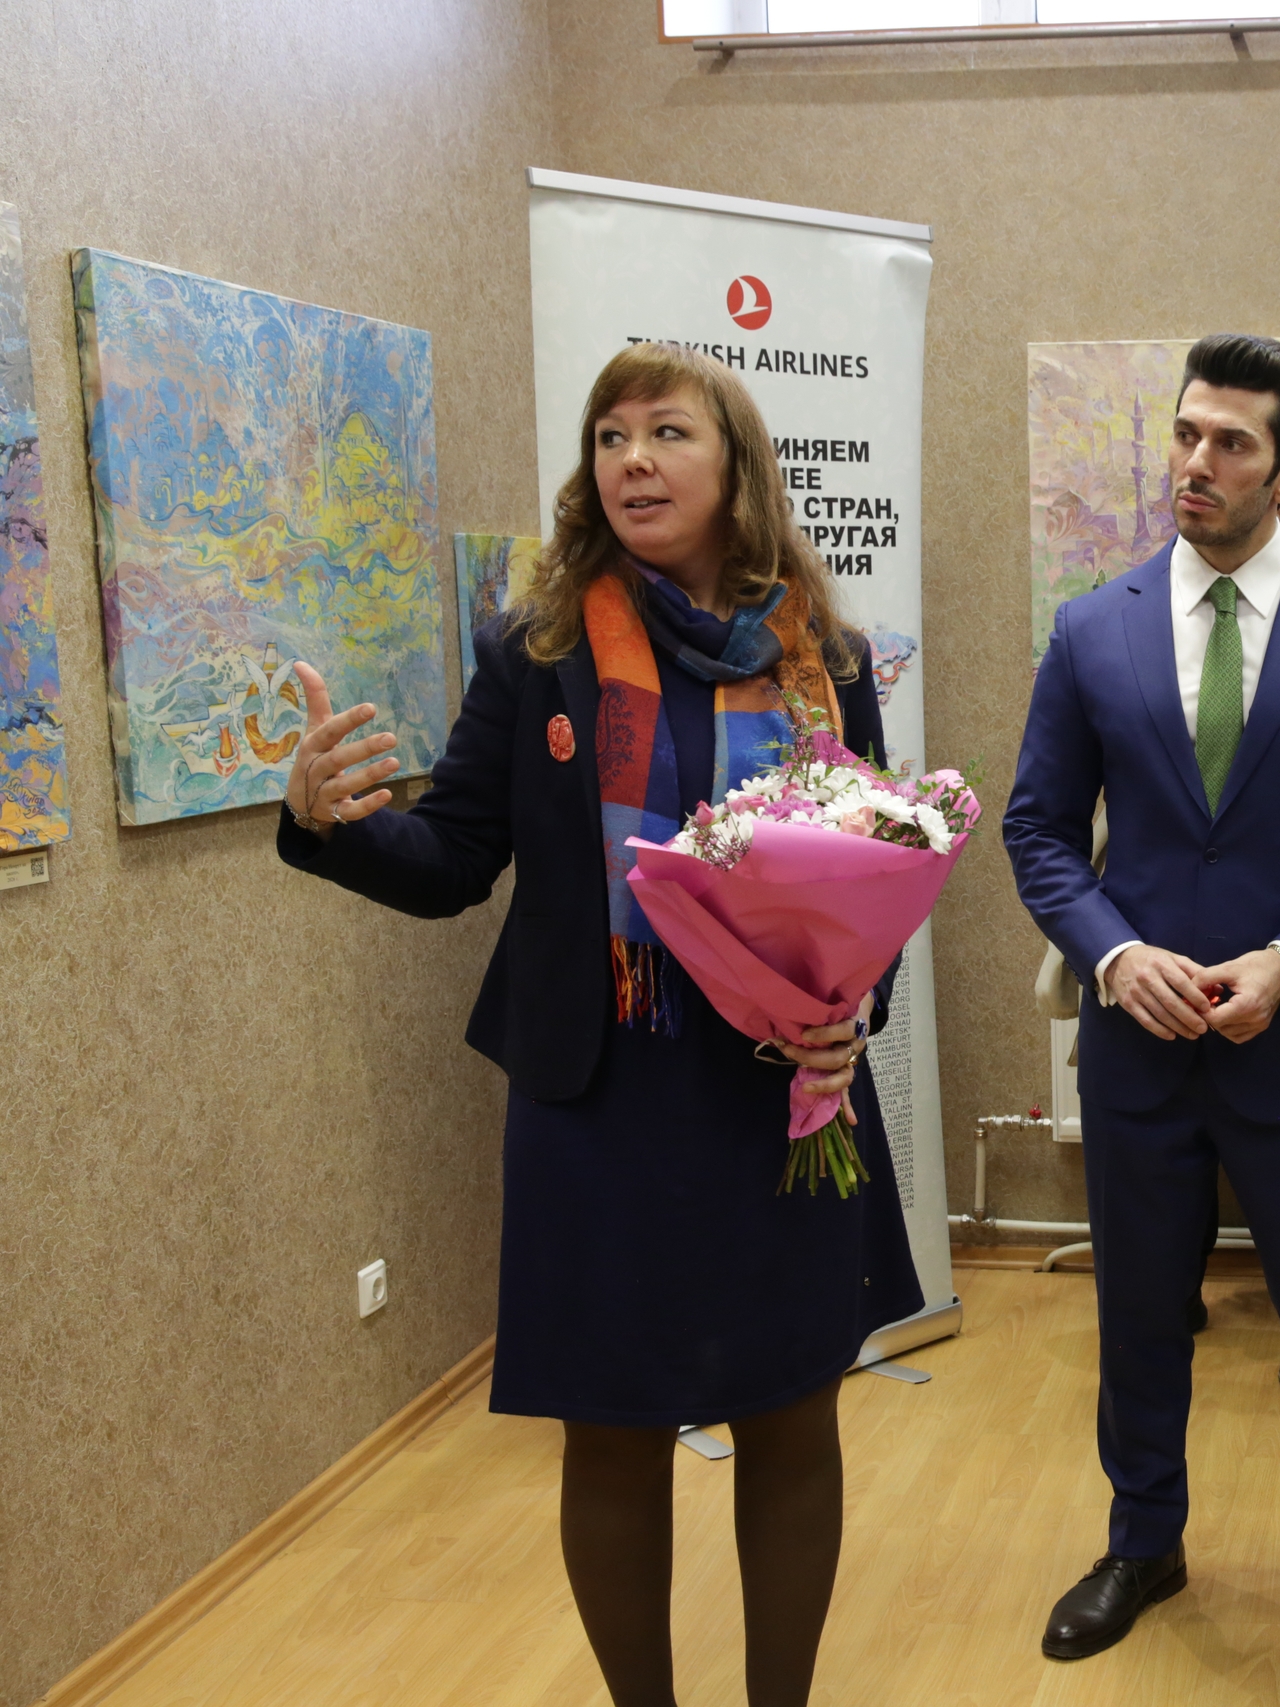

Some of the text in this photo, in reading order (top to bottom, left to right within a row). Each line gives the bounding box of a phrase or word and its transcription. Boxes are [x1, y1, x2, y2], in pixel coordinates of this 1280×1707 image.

[755, 348, 869, 379] AIRLINES
[804, 496, 899, 525] СТРАН,
[889, 1011, 911, 1020] OGNA
[867, 1034, 911, 1048] FRANKFURT
[875, 1041, 912, 1054] HAMBURG
[881, 1057, 912, 1069] LONDON
[872, 1065, 912, 1078] MARSEILLE
[895, 1072, 912, 1082] NICE
[884, 1103, 913, 1115] TALLINN
[889, 1111, 913, 1122] VARNA
[886, 1118, 913, 1130] ZURICH
[893, 1134, 913, 1144] ERBIL
